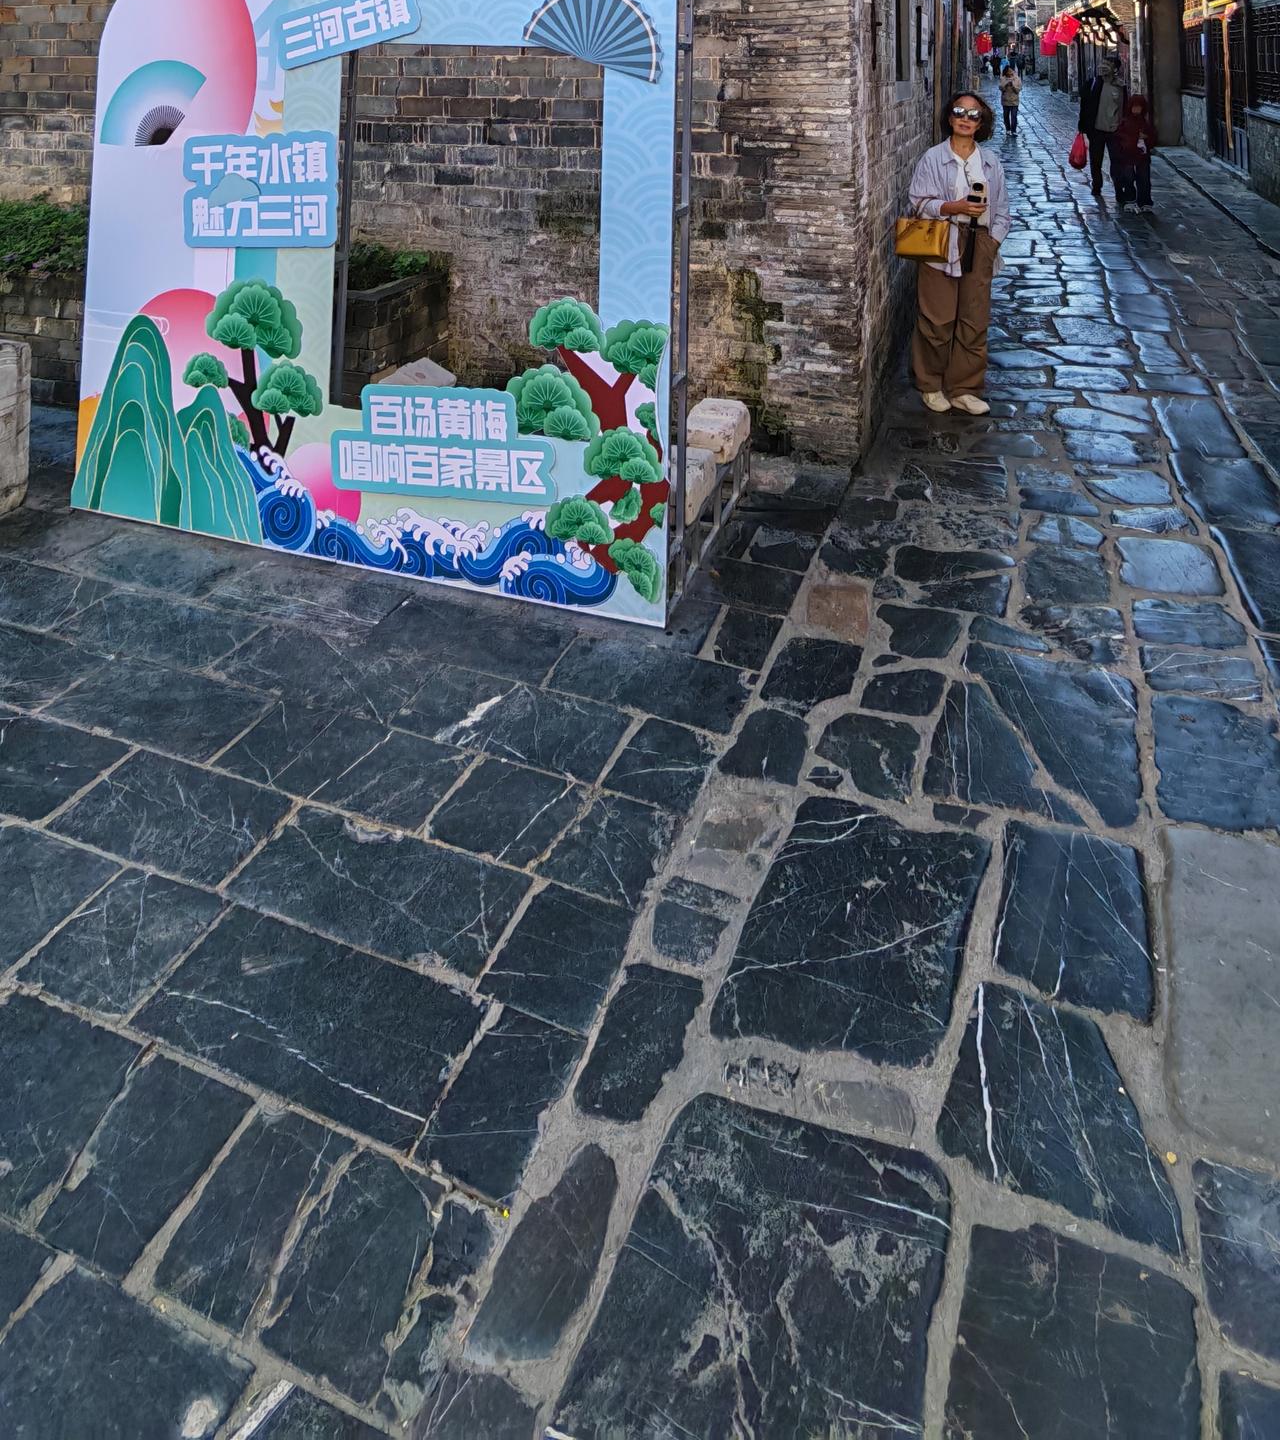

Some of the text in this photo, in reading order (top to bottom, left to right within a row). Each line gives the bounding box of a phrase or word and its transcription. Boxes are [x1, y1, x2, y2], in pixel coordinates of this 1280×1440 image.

[190, 140, 329, 186] 千年水镇
[191, 194, 329, 238] 魅力三河
[368, 394, 508, 443] 百场黄梅
[338, 439, 548, 496] 唱响百家景区
